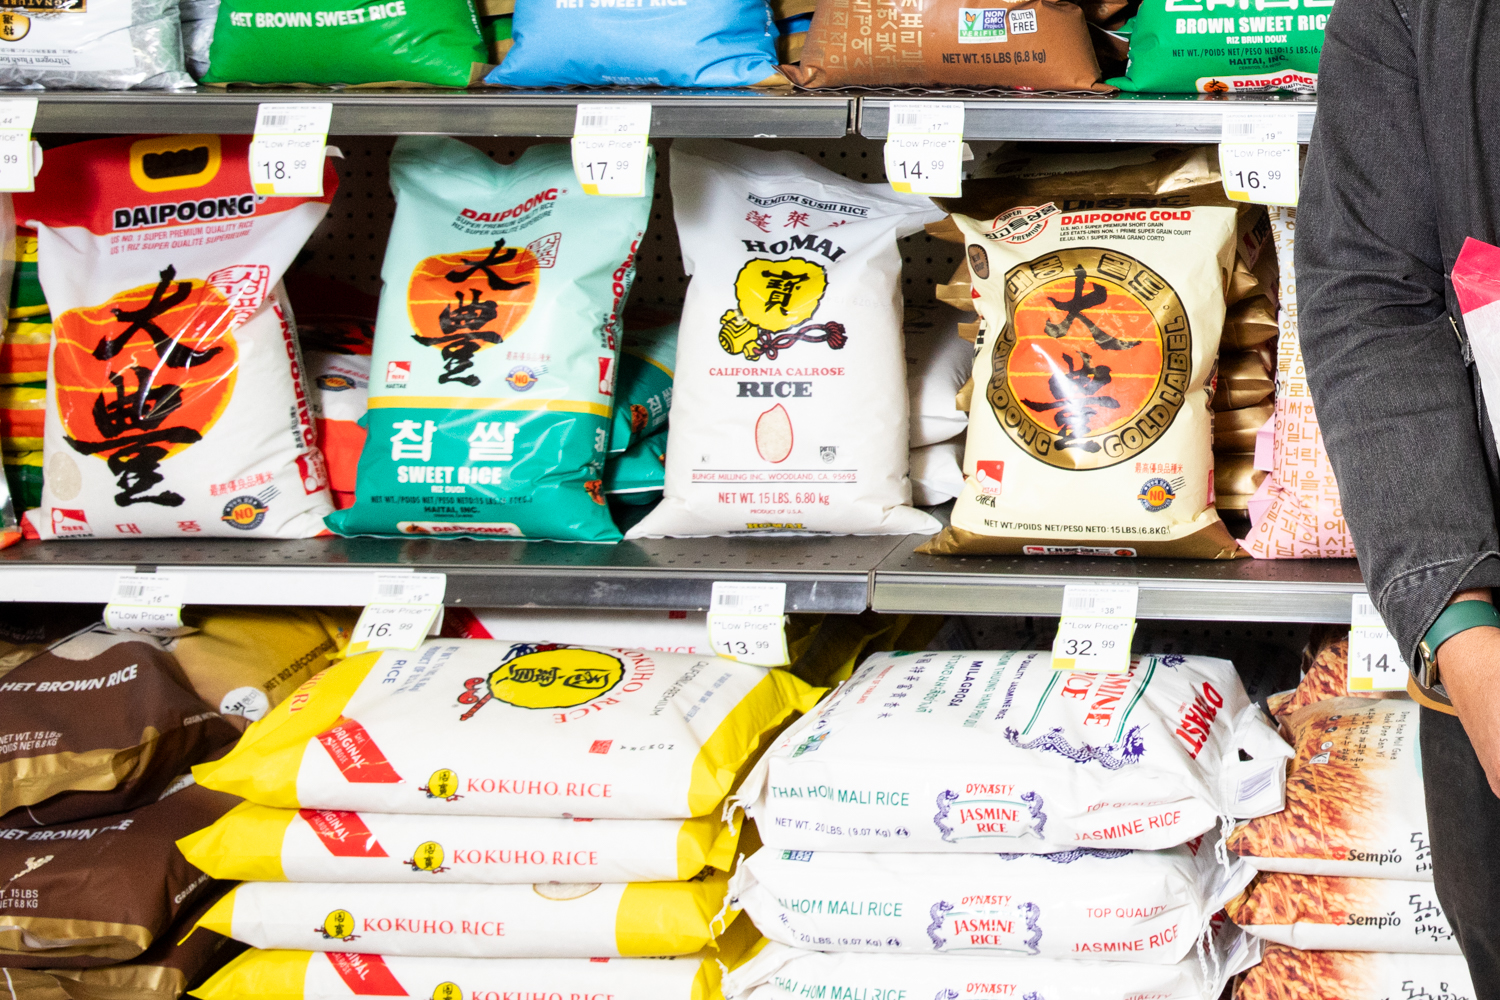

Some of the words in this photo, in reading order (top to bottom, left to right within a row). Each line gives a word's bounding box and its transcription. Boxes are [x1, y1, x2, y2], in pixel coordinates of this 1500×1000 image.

[230, 10, 252, 28] HET
[254, 9, 312, 29] BROWN
[315, 7, 366, 27] SWEET
[369, 0, 407, 21] RICE
[1176, 16, 1234, 35] BROWN
[1239, 15, 1293, 34] SWEET
[943, 52, 961, 64] NET
[963, 52, 978, 64] WT.
[981, 52, 993, 64] 15
[994, 51, 1011, 64] LBS
[1013, 50, 1030, 64] (6.8
[1032, 50, 1047, 64] kg)
[114, 194, 254, 229] DAIPOONG
[747, 192, 798, 207] PREMIUM
[801, 193, 837, 213] SUSHI
[838, 203, 869, 217] RICE
[1061, 212, 1146, 225] DAIPOONG
[1150, 211, 1191, 221] GOLD
[742, 234, 847, 263] HOMAI
[709, 367, 782, 377] CALIFORNIA
[786, 367, 845, 377] CALROSE
[736, 381, 813, 398] RICE
[397, 466, 454, 484] SWEET
[458, 465, 502, 485] RICE
[717, 472, 747, 481] MILLING
[749, 472, 765, 481] INC.
[832, 471, 857, 481] 95695
[1, 682, 34, 693] HET
[36, 676, 105, 692] BROWN
[107, 664, 138, 686] RICE
[467, 777, 562, 797] KOKUHO
[566, 781, 612, 799] RICE
[771, 785, 804, 800] THAI
[805, 787, 835, 803] HOM
[837, 790, 872, 804] MALI
[876, 792, 910, 807] RICE
[959, 806, 1020, 824] JASMINE
[977, 820, 1008, 835] RICE
[1074, 817, 1145, 843] JASMINE
[1148, 809, 1182, 830] RICE
[1347, 848, 1402, 865] Sempio
